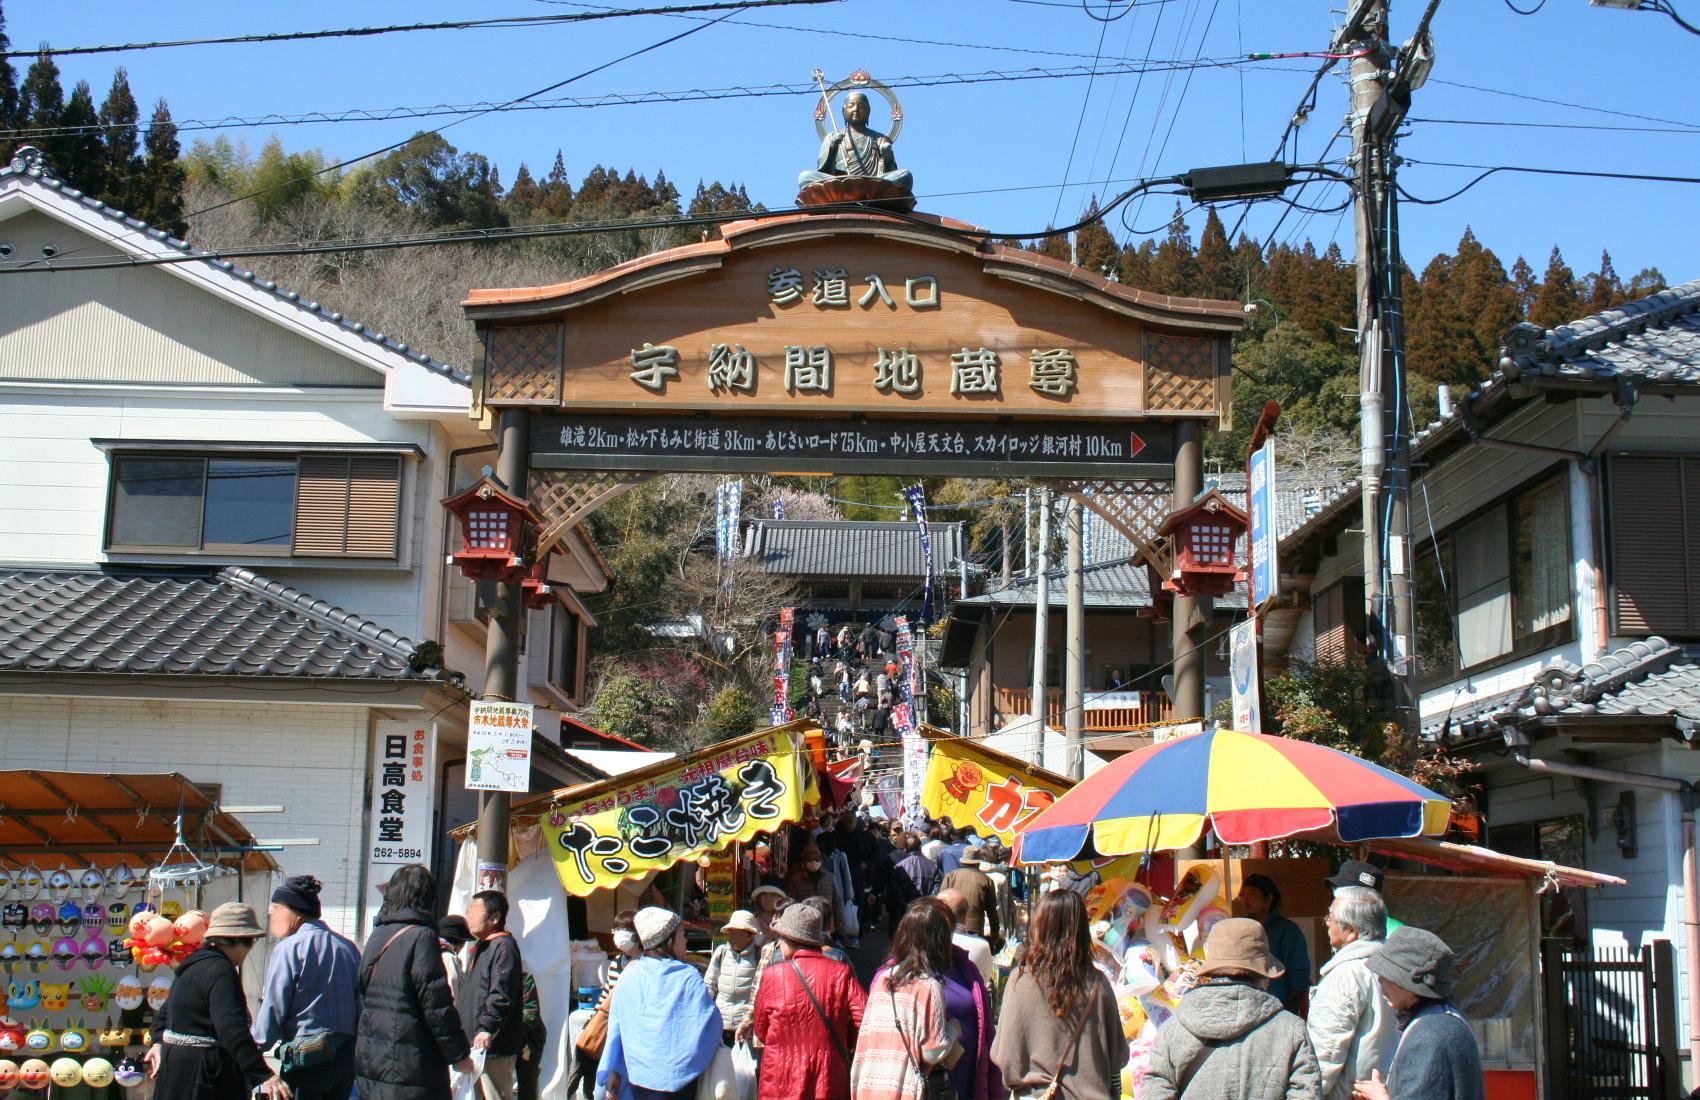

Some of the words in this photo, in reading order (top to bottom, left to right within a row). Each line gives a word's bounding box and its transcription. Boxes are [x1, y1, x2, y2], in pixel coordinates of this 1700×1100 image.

[768, 266, 939, 308] 参道入口
[629, 342, 1077, 396] 宇納間地蔵尊
[411, 729, 425, 782] お食事処
[378, 735, 407, 842] 日高食堂
[558, 758, 788, 884] たこ焼き
[381, 847, 422, 858] 62-5894
